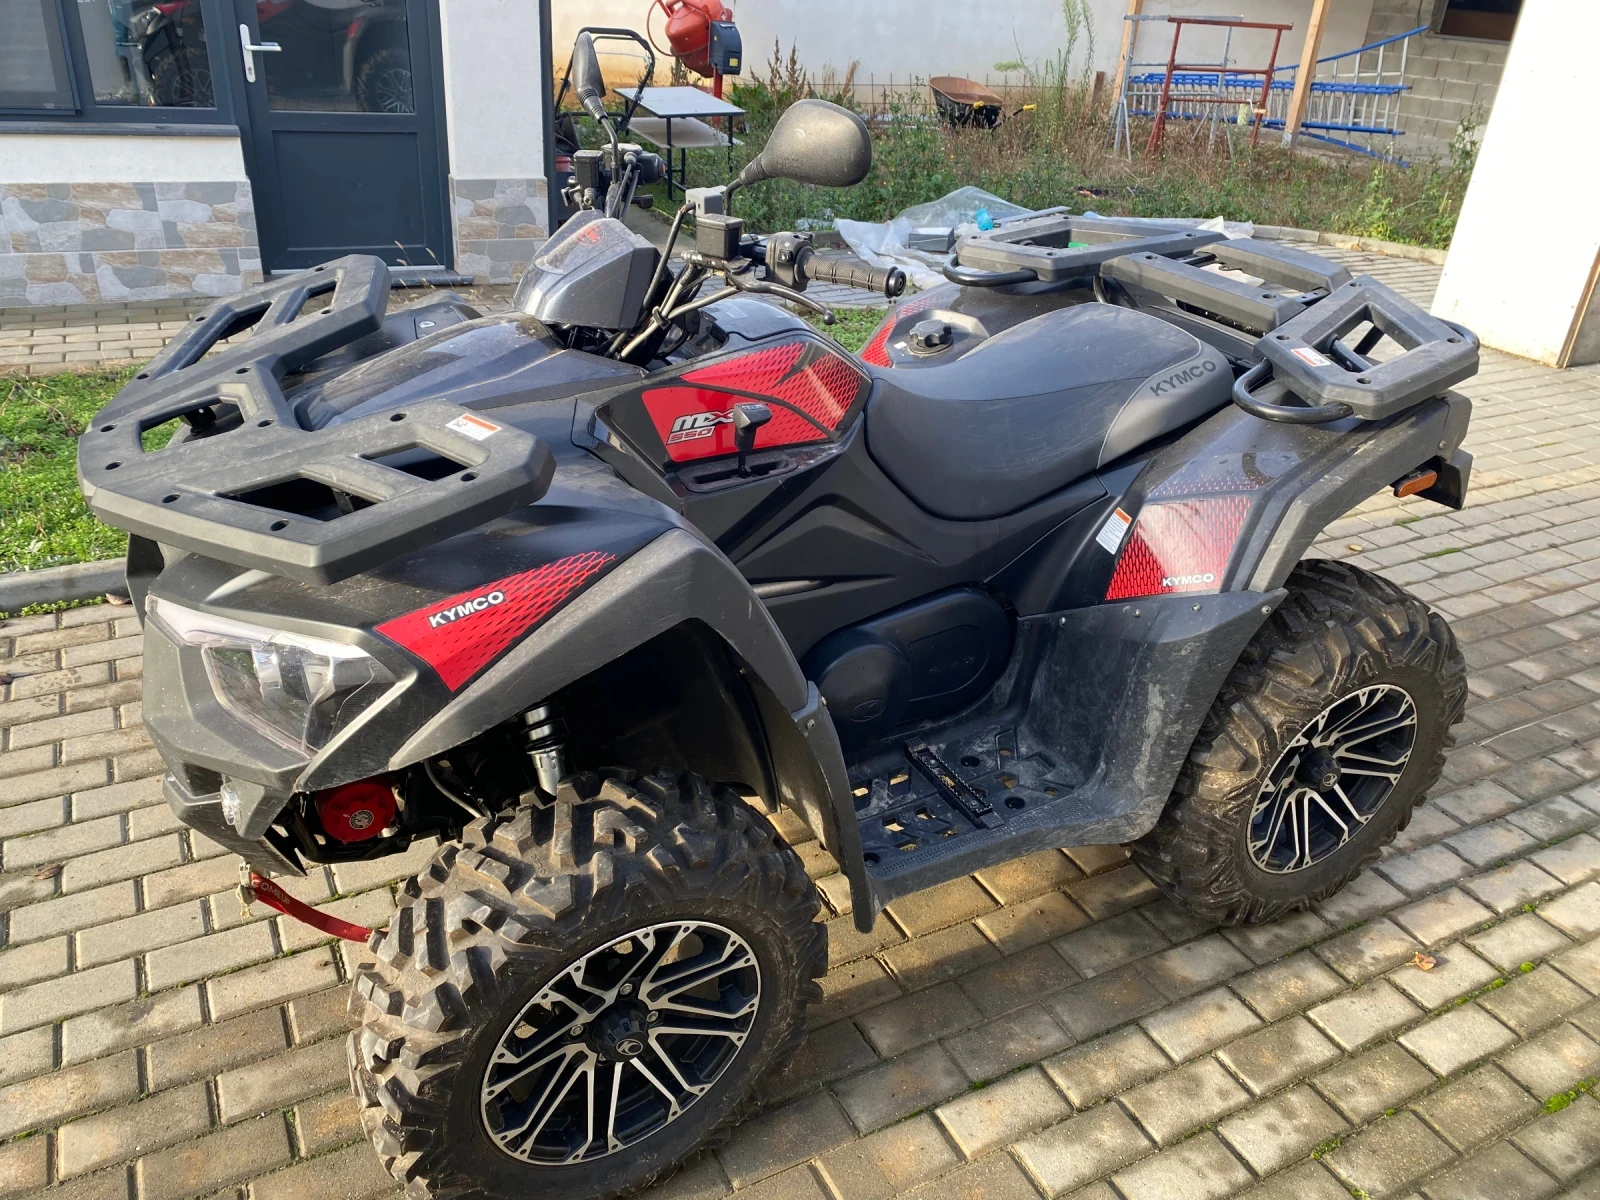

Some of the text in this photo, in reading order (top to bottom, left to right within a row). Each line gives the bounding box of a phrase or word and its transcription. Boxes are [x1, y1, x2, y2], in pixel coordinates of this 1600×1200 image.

[1150, 360, 1216, 396] KYMCO
[671, 409, 735, 432] MX
[669, 428, 712, 441] 550
[1162, 573, 1214, 587] KYMCO
[428, 591, 504, 628] KYMCO
